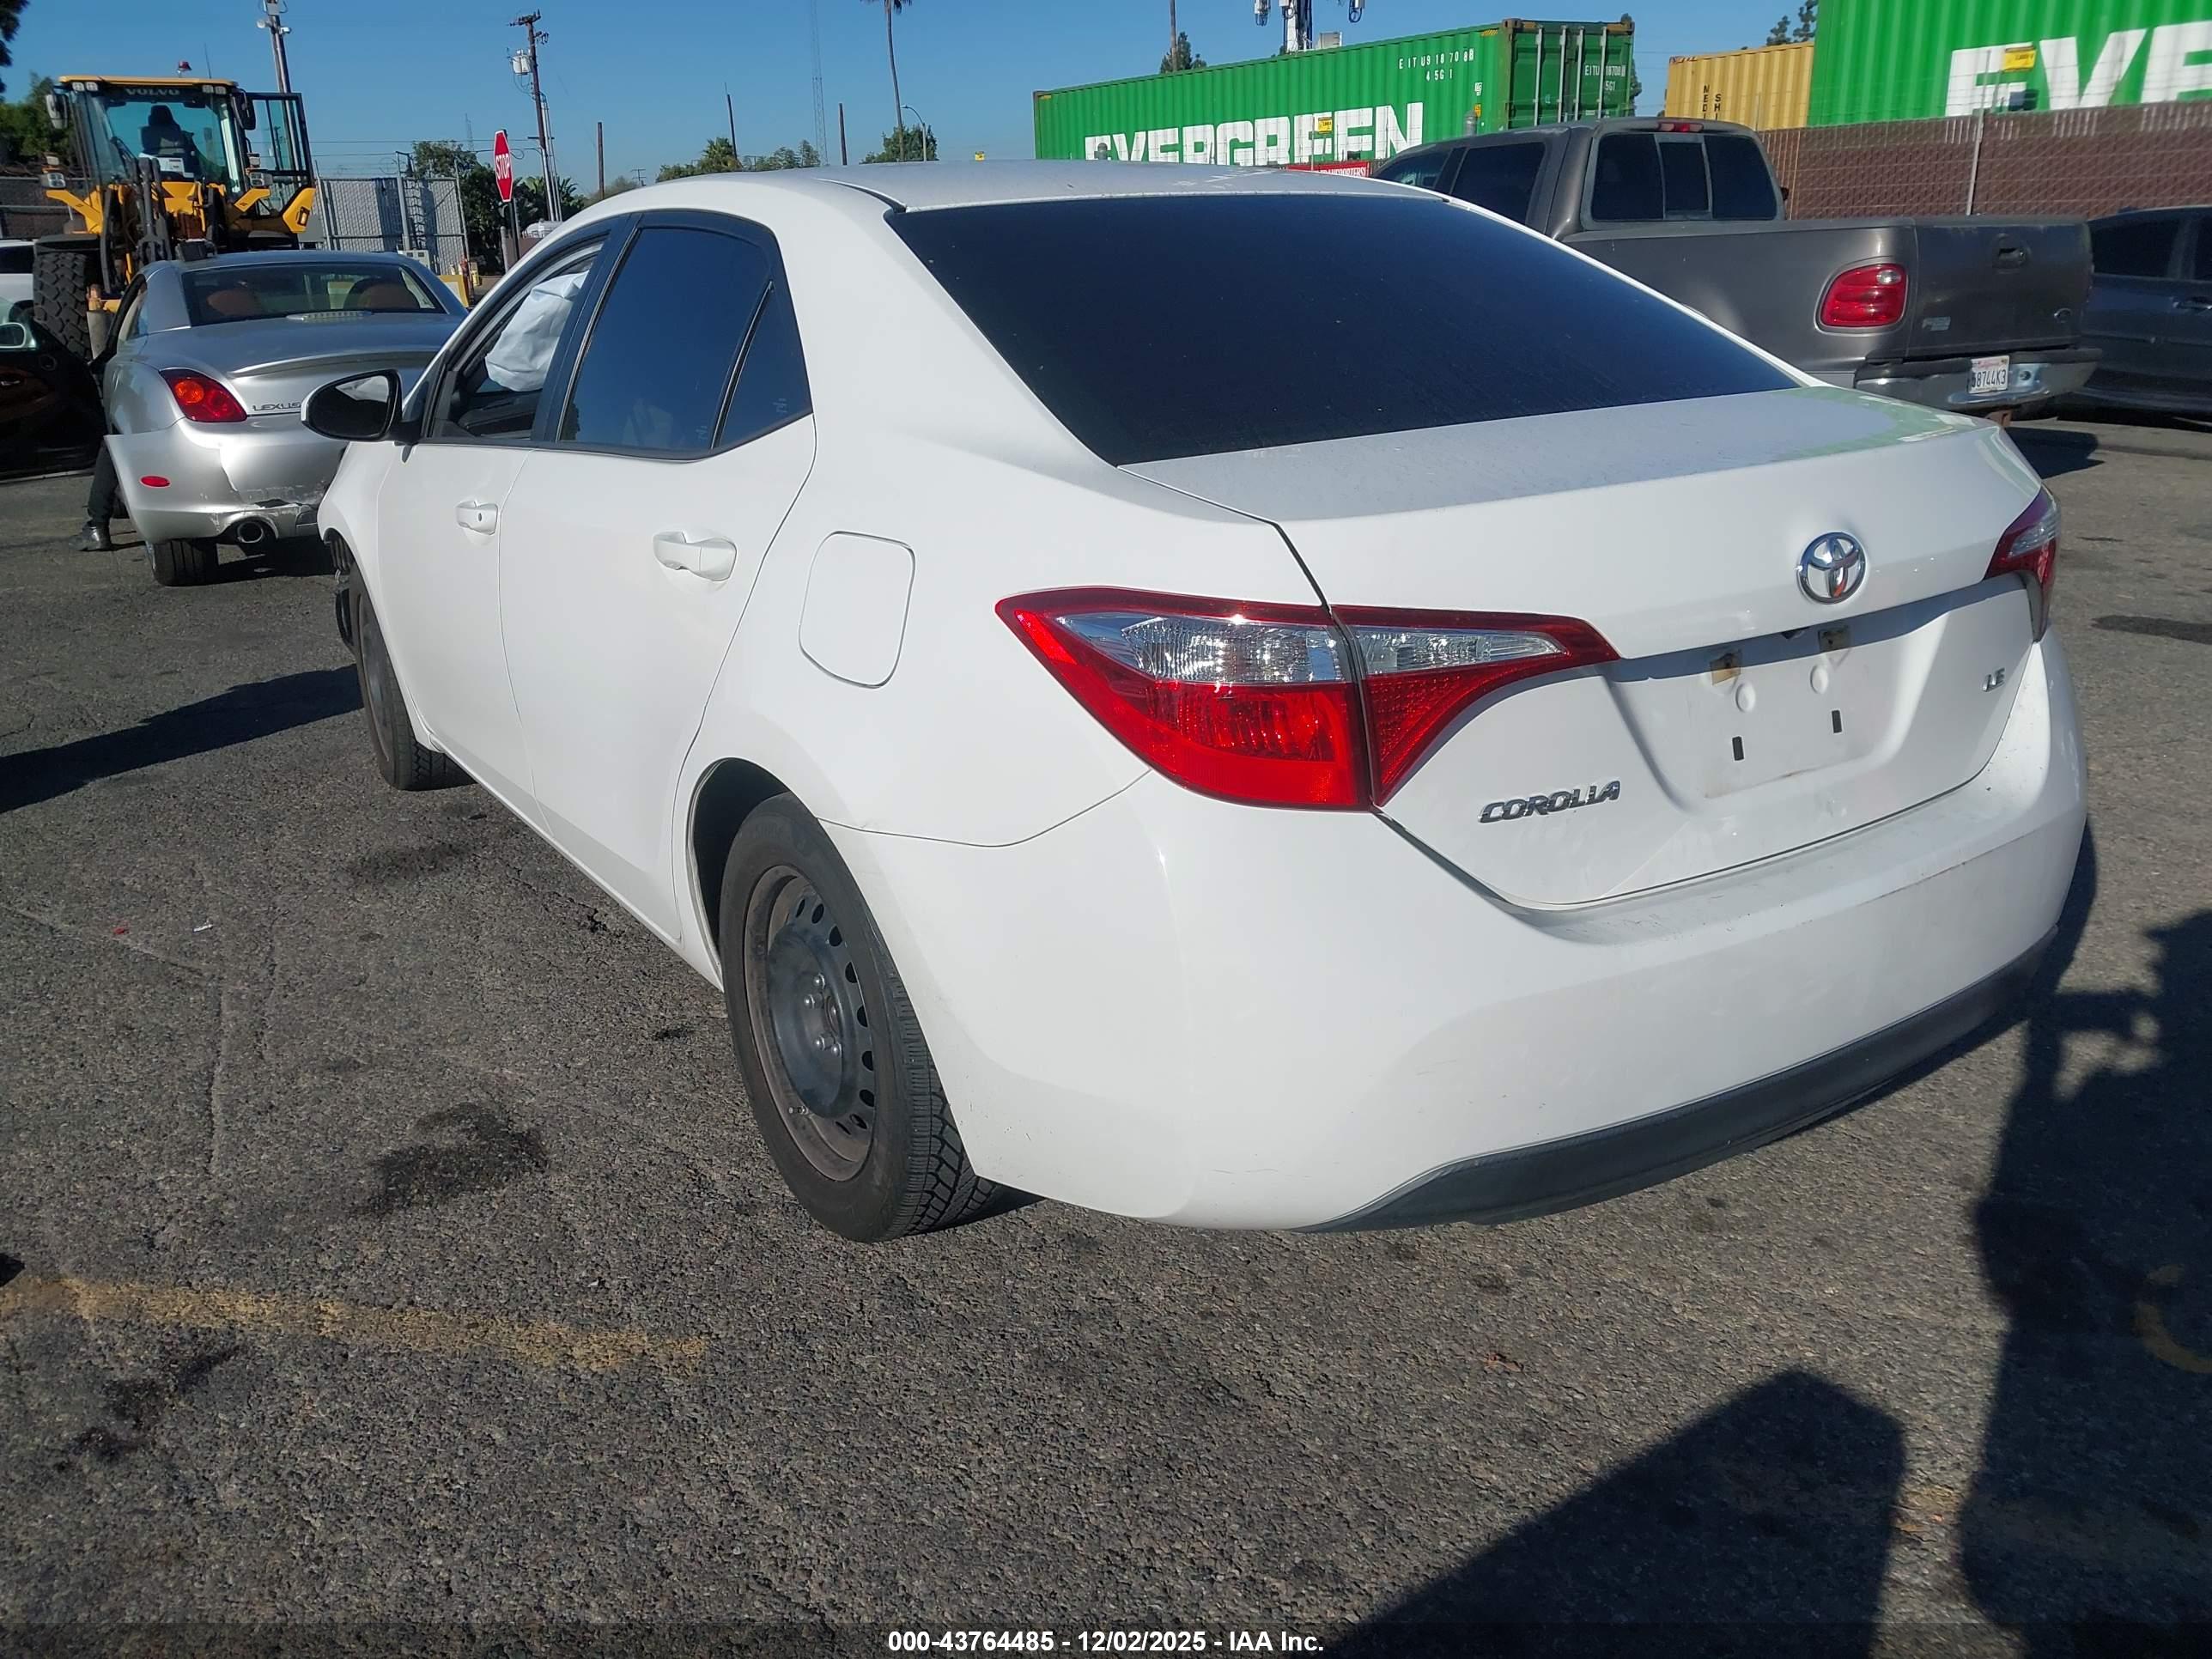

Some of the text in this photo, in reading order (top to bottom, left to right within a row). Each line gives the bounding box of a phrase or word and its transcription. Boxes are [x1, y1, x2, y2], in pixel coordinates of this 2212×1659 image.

[1604, 81, 1616, 91] 5G1
[495, 153, 510, 180] STOP
[252, 402, 301, 410] LEXUS
[1982, 667, 2005, 692] LE
[1479, 780, 1621, 823] COROLLA
